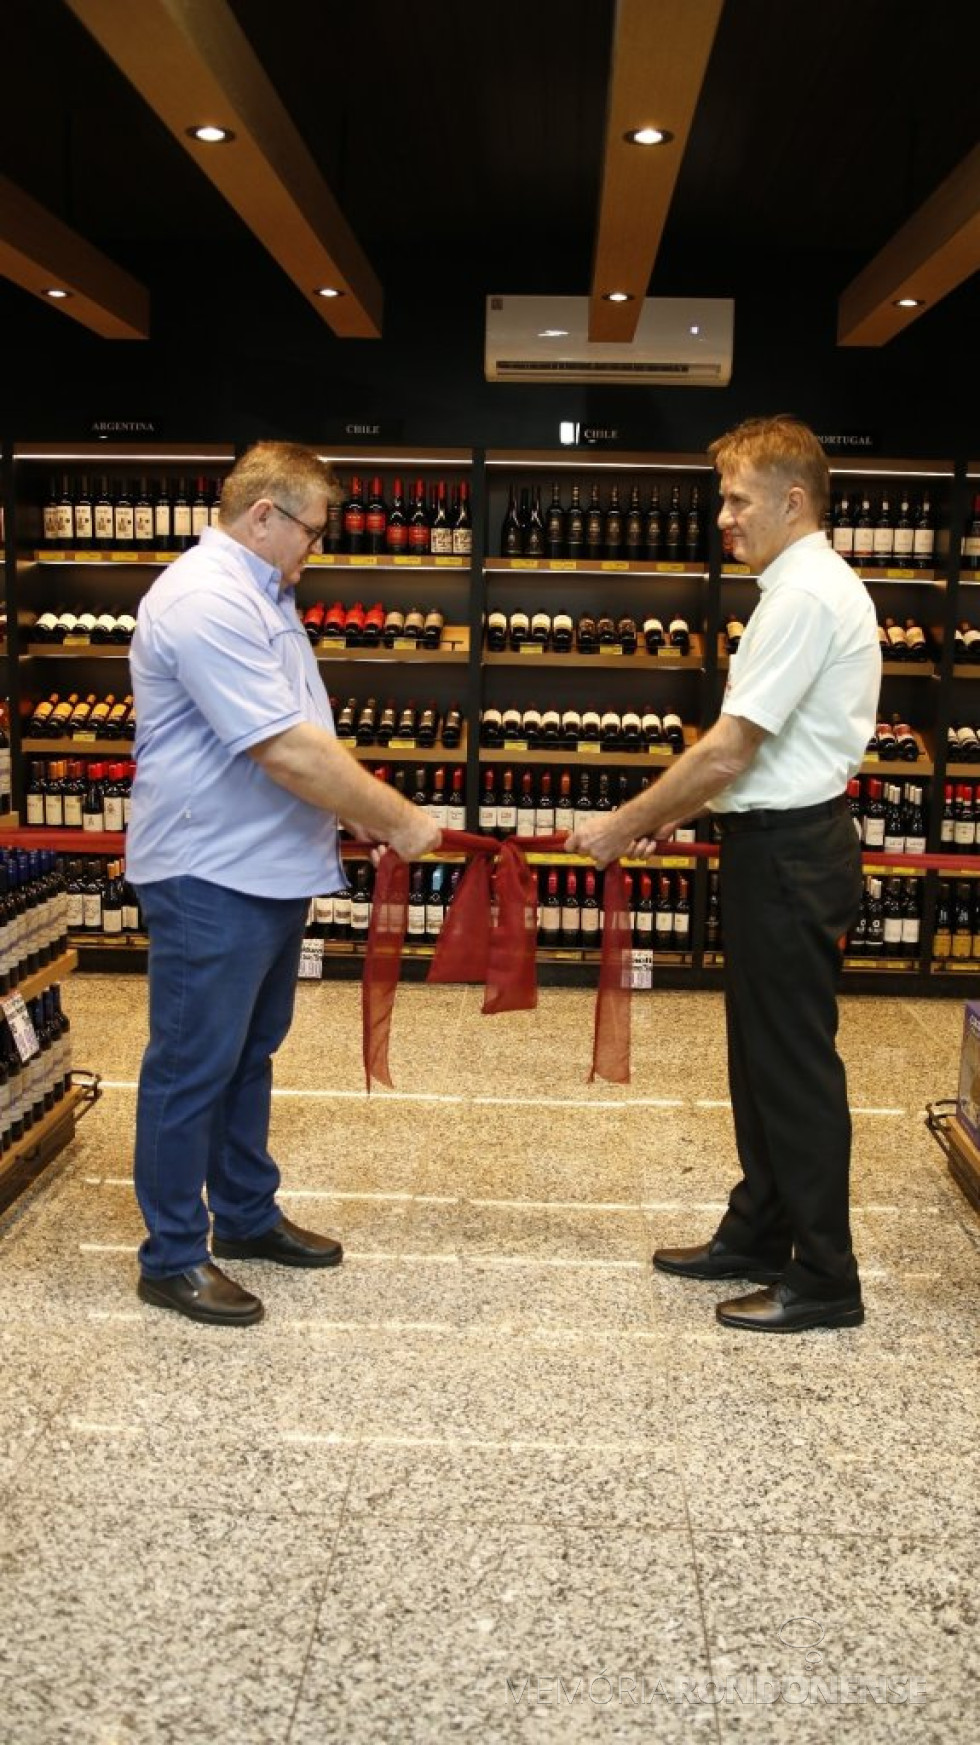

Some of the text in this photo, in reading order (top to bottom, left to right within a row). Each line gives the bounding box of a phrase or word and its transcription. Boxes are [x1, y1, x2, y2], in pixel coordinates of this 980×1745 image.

[92, 422, 154, 431] ARGENTINA
[345, 425, 380, 433] CHILE
[584, 429, 618, 439] CHILE
